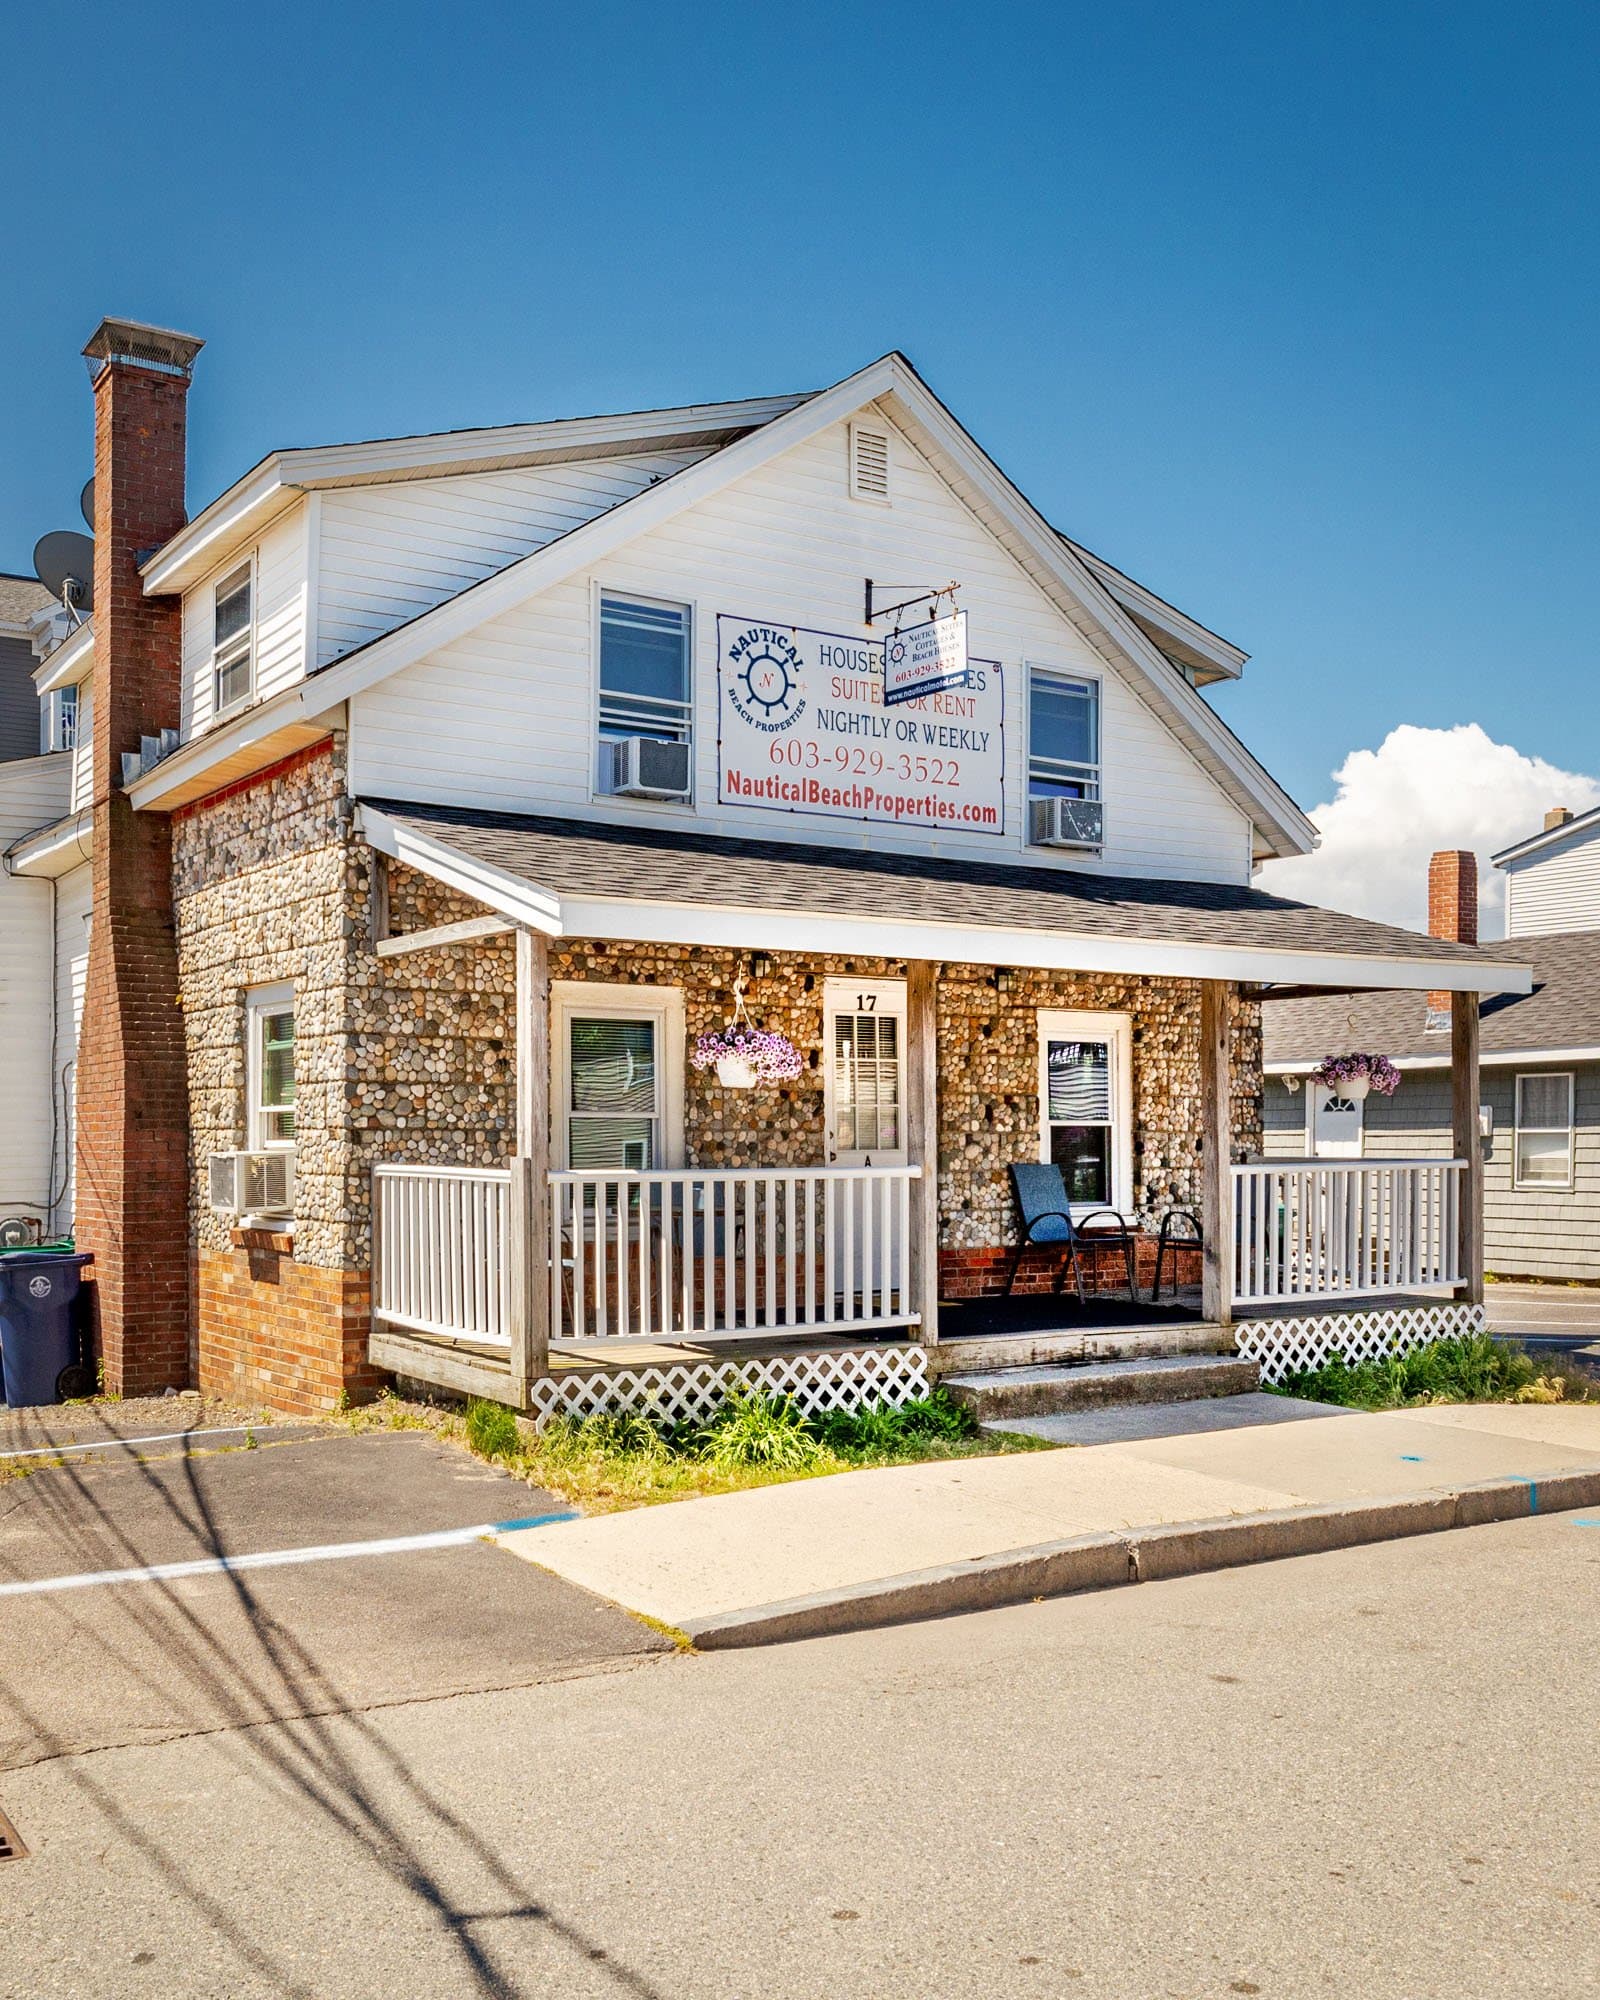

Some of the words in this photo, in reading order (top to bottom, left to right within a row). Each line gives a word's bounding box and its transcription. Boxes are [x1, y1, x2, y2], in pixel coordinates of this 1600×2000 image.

[728, 628, 804, 673] NAUTICAL
[759, 672, 775, 689] N
[895, 657, 956, 683] 603-929-3522
[728, 688, 754, 725] BEACH
[755, 698, 807, 733] PROPERTIES
[934, 691, 976, 718] RENT
[817, 708, 891, 738] NIGHTLY
[896, 719, 918, 743] OR
[922, 724, 990, 752] WEEKLY
[769, 737, 960, 786] 603-929-3522
[727, 769, 997, 824] NauticalBeachProperties.com
[856, 994, 877, 1011] 17
[864, 1155, 872, 1167] A
